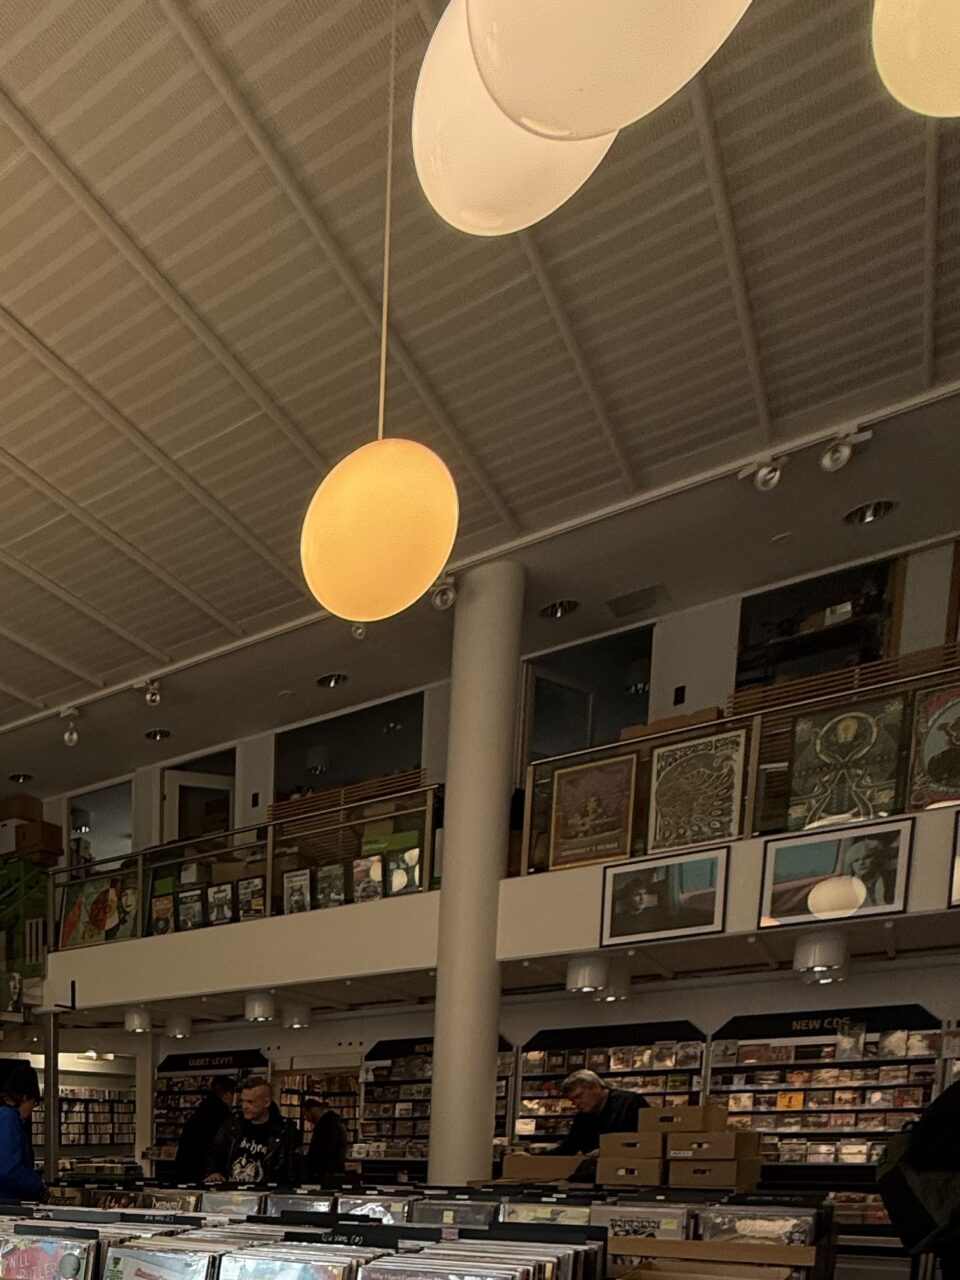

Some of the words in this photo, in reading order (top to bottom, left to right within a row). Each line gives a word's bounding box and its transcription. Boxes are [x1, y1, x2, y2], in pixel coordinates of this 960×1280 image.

[792, 1018, 821, 1031] NEW
[212, 1056, 234, 1065] LEVYT
[7, 1251, 30, 1268] WILL
